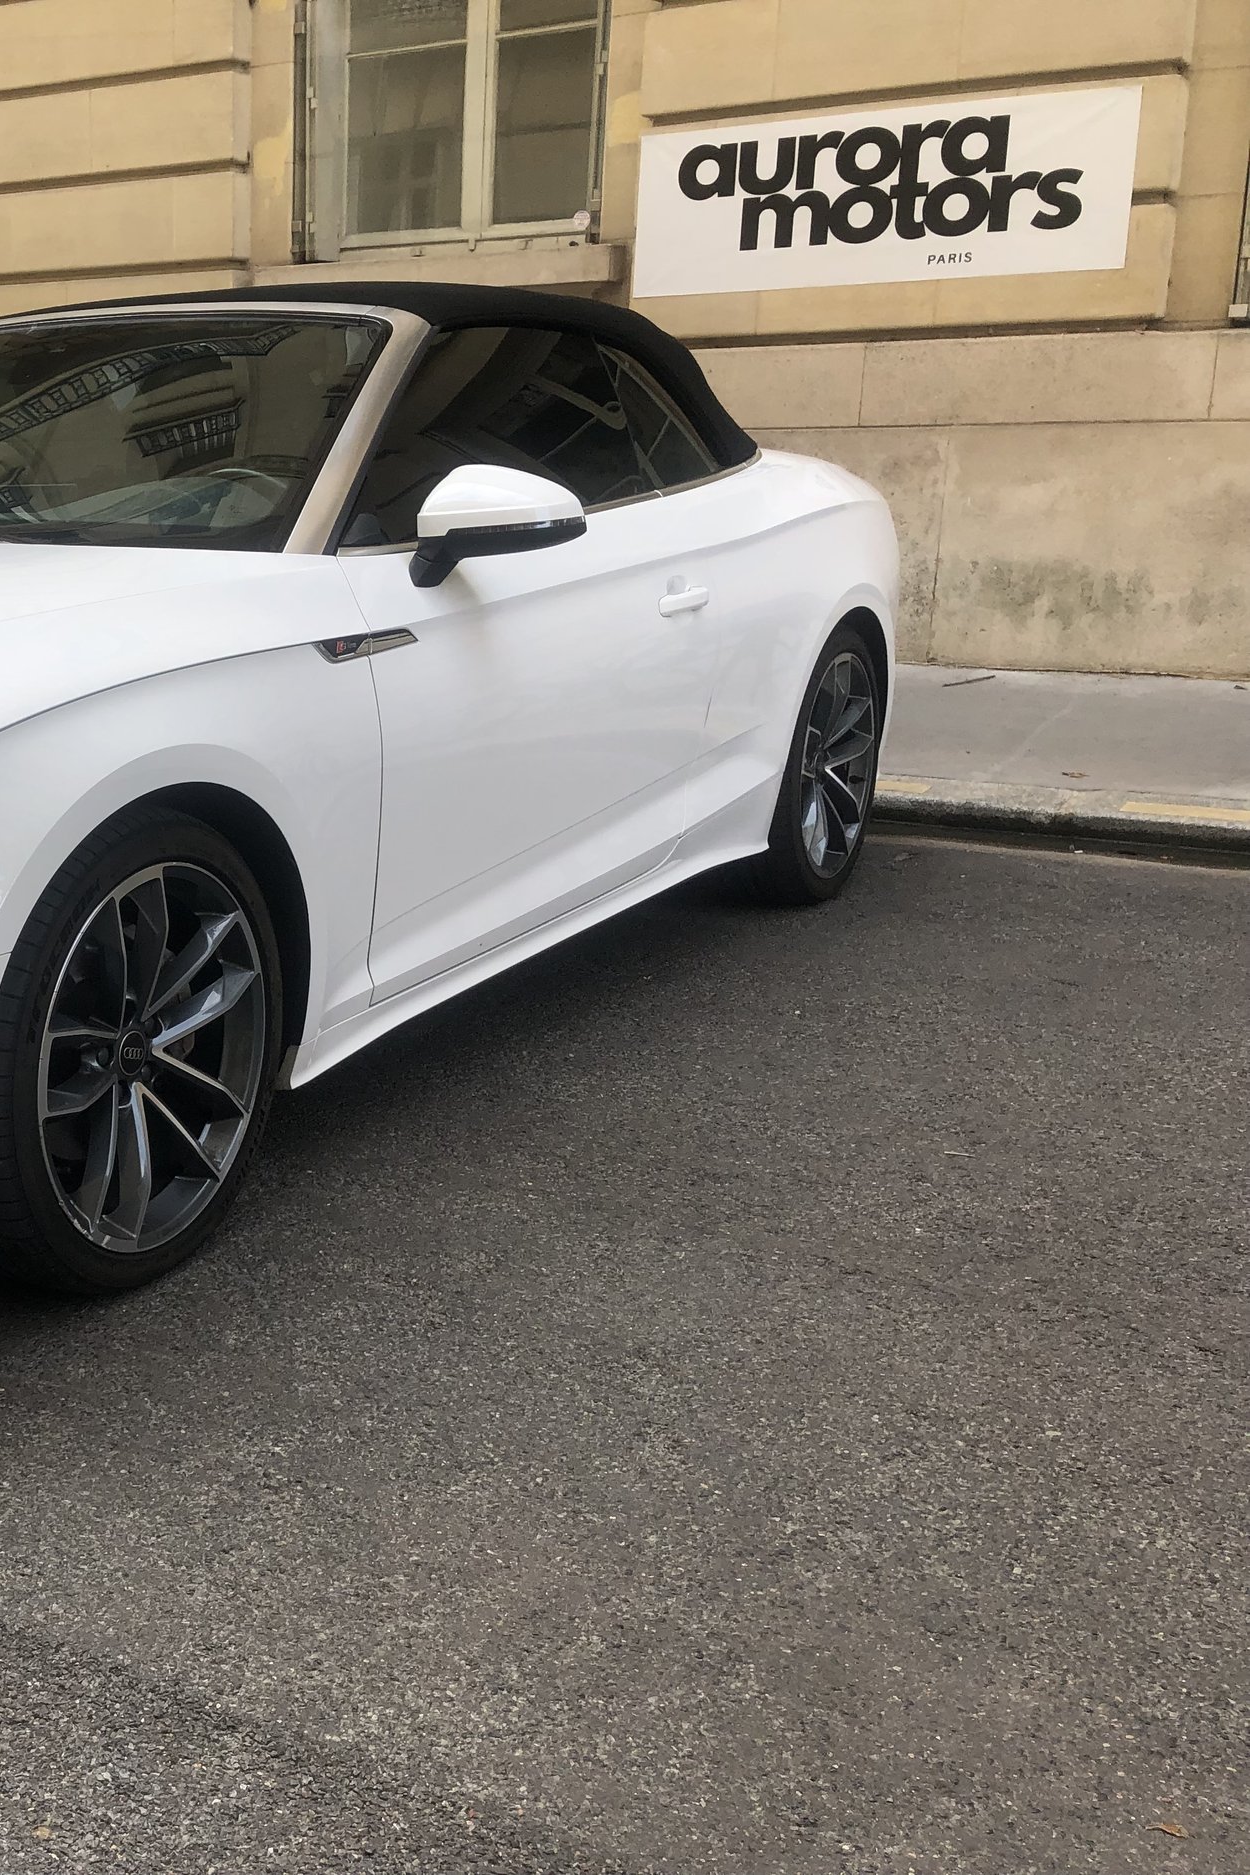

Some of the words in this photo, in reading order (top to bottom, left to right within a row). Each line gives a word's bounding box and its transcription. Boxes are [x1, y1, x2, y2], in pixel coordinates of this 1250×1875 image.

[678, 114, 1011, 201] aurora
[739, 168, 1084, 251] motors
[927, 251, 973, 266] PARIS
